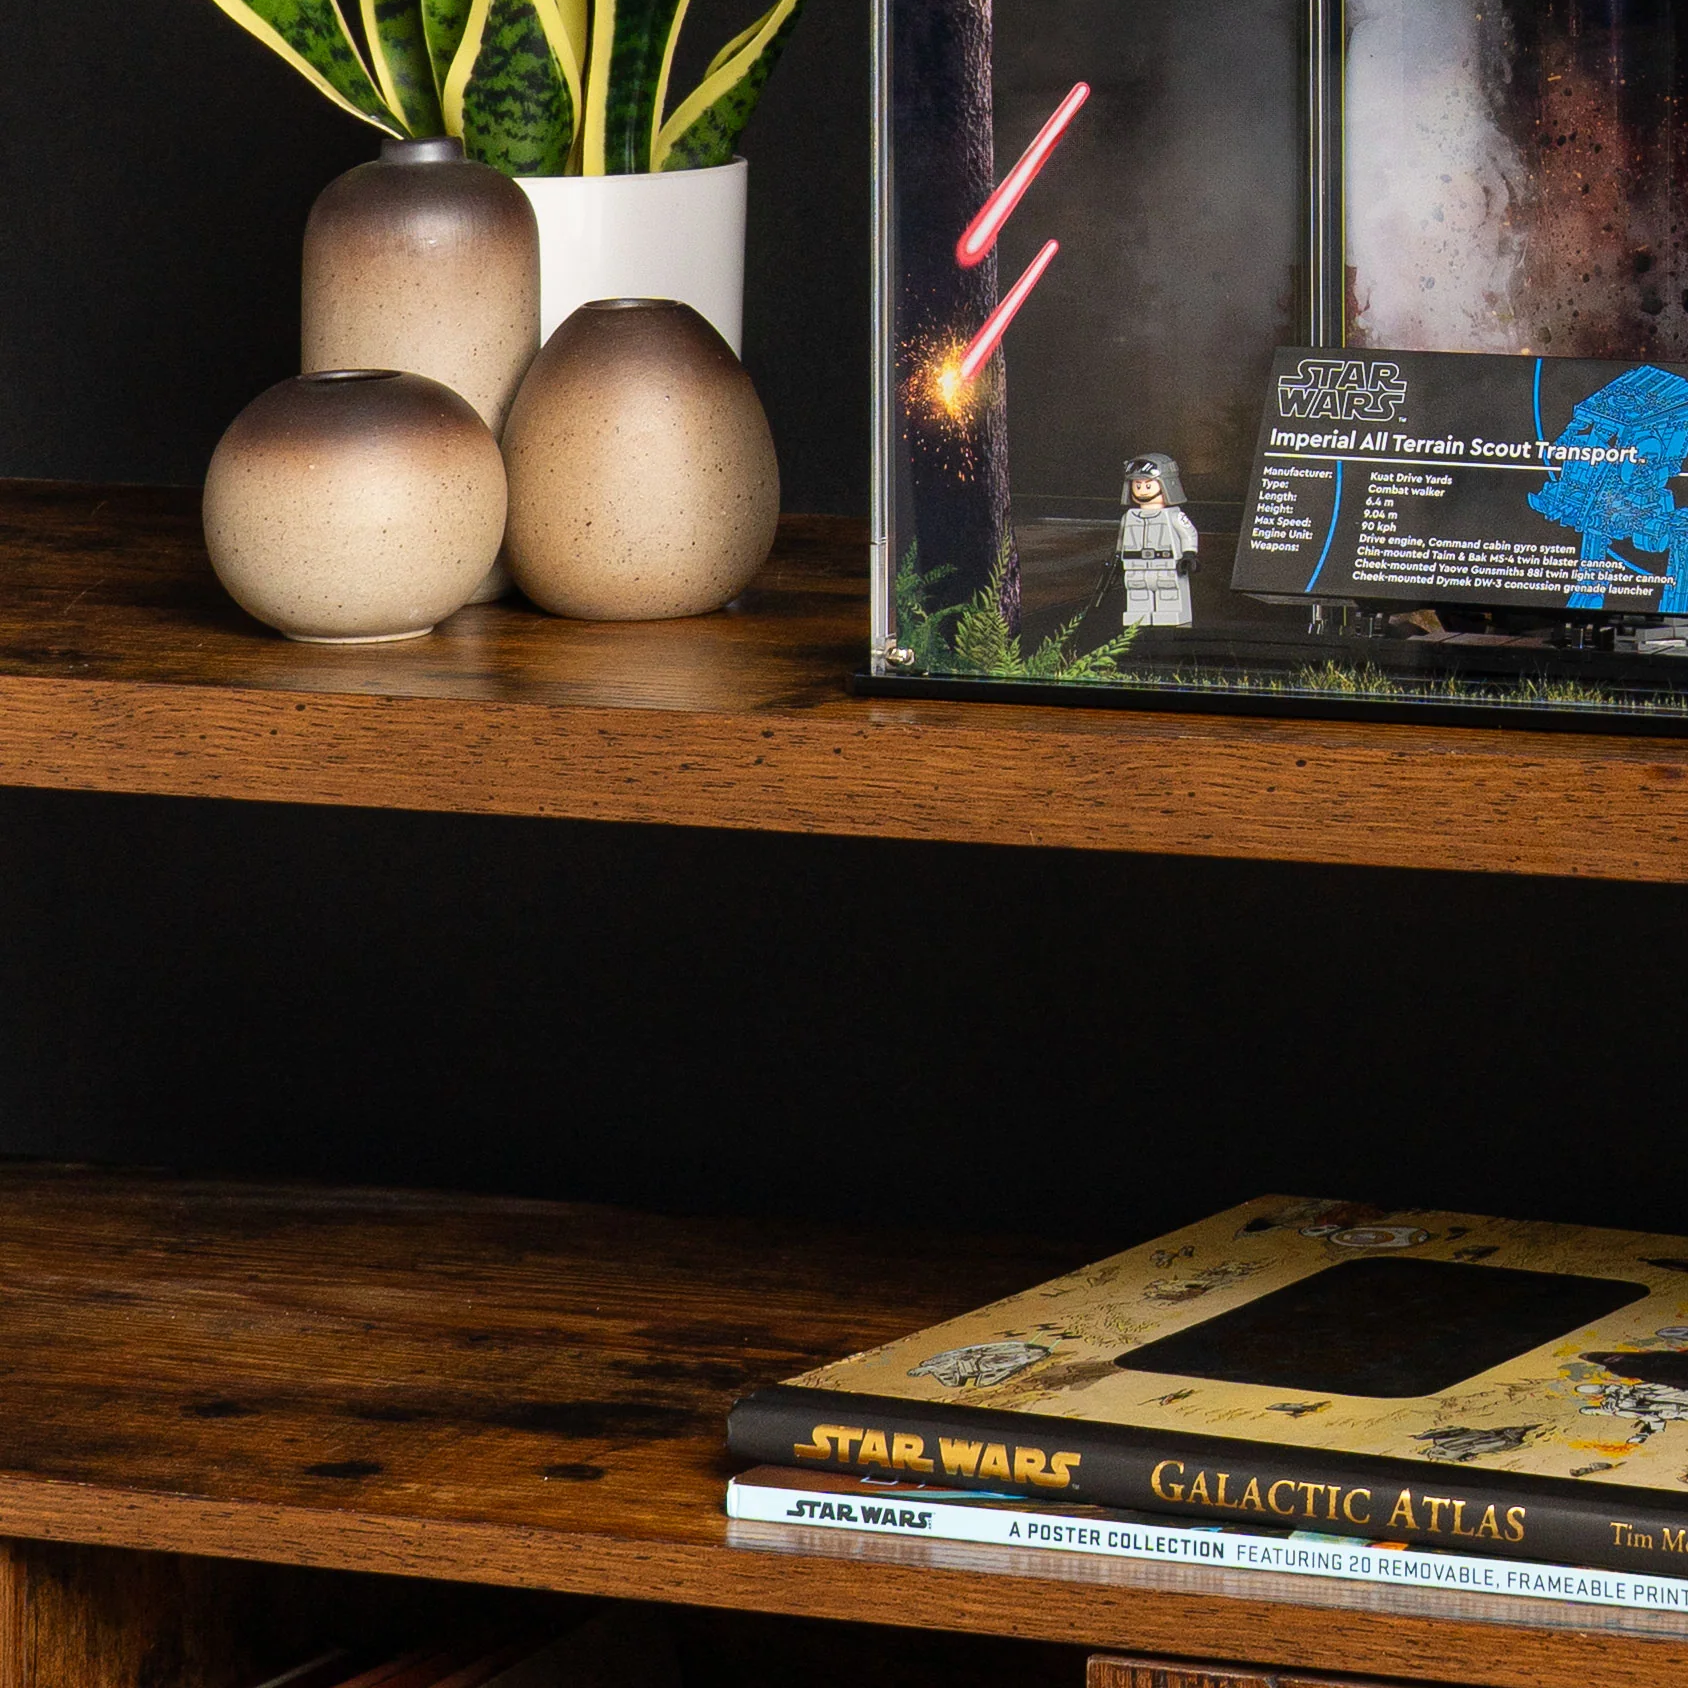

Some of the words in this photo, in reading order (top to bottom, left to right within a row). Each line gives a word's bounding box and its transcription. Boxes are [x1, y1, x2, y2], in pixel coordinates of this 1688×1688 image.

[1278, 359, 1407, 392] STAR
[1278, 387, 1405, 421] WARS
[1270, 428, 1356, 451] Imperial
[1359, 431, 1388, 452] All
[1392, 434, 1464, 455] Terrain
[1470, 438, 1531, 459] Scout
[1263, 466, 1333, 479] Manufacturer:
[1370, 471, 1394, 483] Kuat
[1396, 472, 1423, 484] Drive
[1425, 474, 1453, 485] Yards
[1261, 479, 1289, 490] Type:
[1368, 484, 1409, 495] Combat
[1411, 486, 1445, 497] walker
[1259, 491, 1297, 503] Length:
[1366, 497, 1382, 507] 6.4
[1383, 499, 1394, 507] m
[1257, 503, 1294, 515] Height:
[1363, 509, 1386, 519] 9.04
[1388, 511, 1398, 520] m
[1254, 515, 1274, 526] Max
[1276, 516, 1312, 528] Speed:
[1361, 521, 1375, 531] 90
[1377, 521, 1397, 533] kph
[1252, 528, 1287, 540] Engine
[1289, 529, 1313, 540] Unit:
[1250, 540, 1300, 552] Weapons:
[1359, 533, 1386, 544] Drive
[1388, 535, 1426, 549] engine,
[1428, 537, 1481, 550] Command
[1483, 540, 1511, 551] cabin
[1513, 544, 1538, 554] gyro
[1540, 544, 1576, 555] system
[1357, 546, 1430, 559] Chin-mounted
[1458, 552, 1466, 561] &
[1468, 552, 1487, 562] Bak
[1490, 554, 1514, 563] MS-4
[1517, 555, 1540, 565] twin
[1542, 557, 1579, 567] blaster
[1580, 560, 1626, 571] cannons,
[1354, 558, 1437, 572] Cheek-mounted
[1470, 565, 1524, 577] Gunsmiths
[1545, 569, 1569, 579] twin
[1570, 570, 1595, 582] light
[1597, 572, 1633, 582] blaster
[1635, 575, 1677, 586] cannon,
[1352, 571, 1435, 585] Cheek-mounted
[1436, 575, 1472, 588] Dymek
[1473, 577, 1502, 588] DW-3
[1504, 580, 1561, 592] concussion
[1563, 582, 1606, 594] grenade
[1608, 586, 1654, 596] launcher
[793, 1424, 934, 1472] STAR
[938, 1437, 1081, 1489] WARS
[1610, 1520, 1653, 1550] Tim
[786, 1499, 858, 1523] STAR
[860, 1505, 932, 1529] WARS
[1009, 1521, 1021, 1538] A
[1028, 1523, 1100, 1546] POSTER
[1108, 1526, 1225, 1559] COLLECTION
[1237, 1545, 1342, 1571] FEATURING
[1349, 1555, 1371, 1574] 20
[1379, 1557, 1500, 1589] REMOVABLE,
[1507, 1571, 1626, 1600] FRAMEABLE
